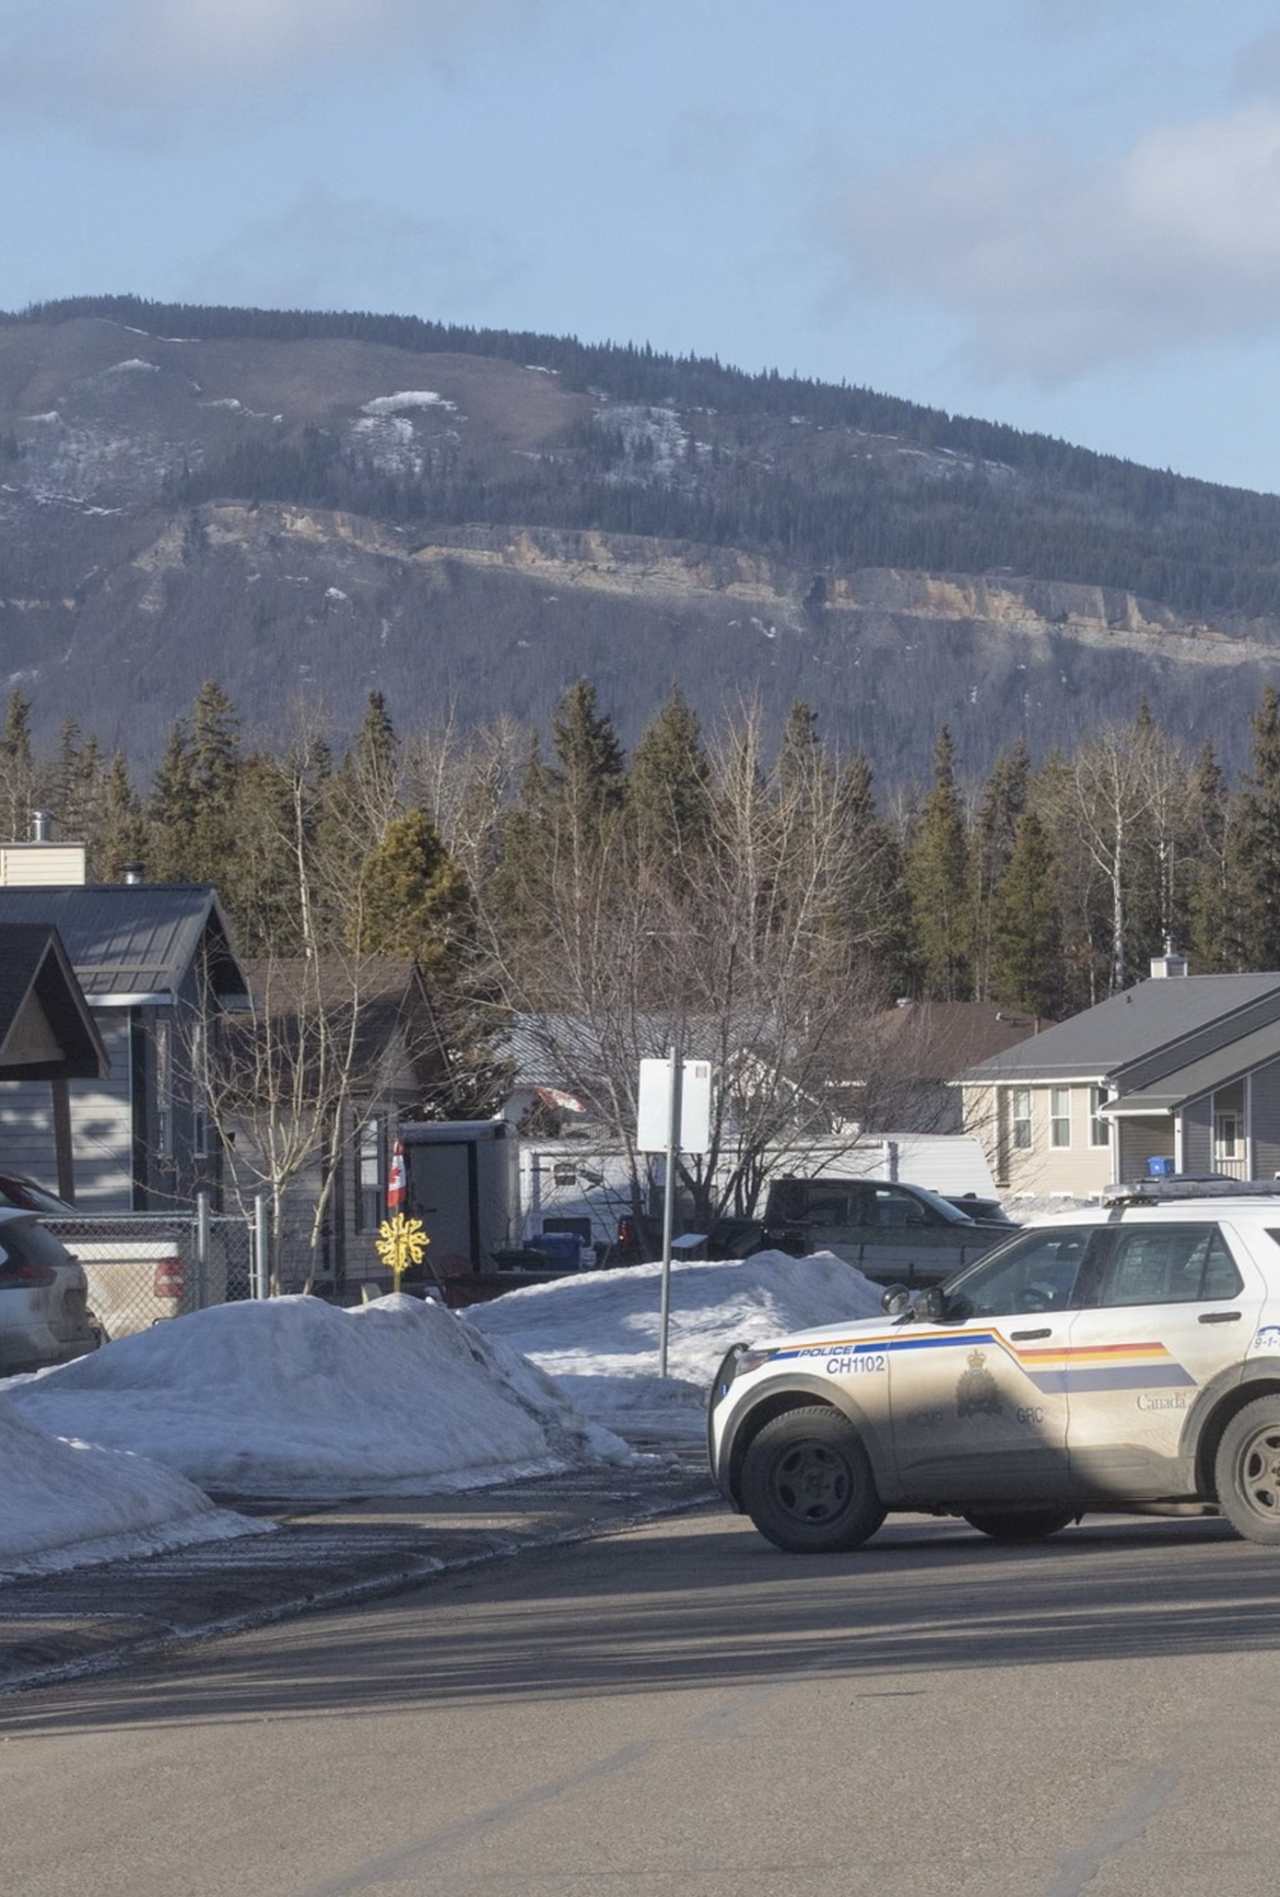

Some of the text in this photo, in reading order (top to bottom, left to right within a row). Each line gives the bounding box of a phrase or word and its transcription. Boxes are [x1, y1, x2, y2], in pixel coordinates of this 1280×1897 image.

[799, 1345, 853, 1357] POLICE
[826, 1355, 885, 1374] CH1102
[1136, 1393, 1186, 1410] Canada
[1016, 1406, 1045, 1424] GRC
